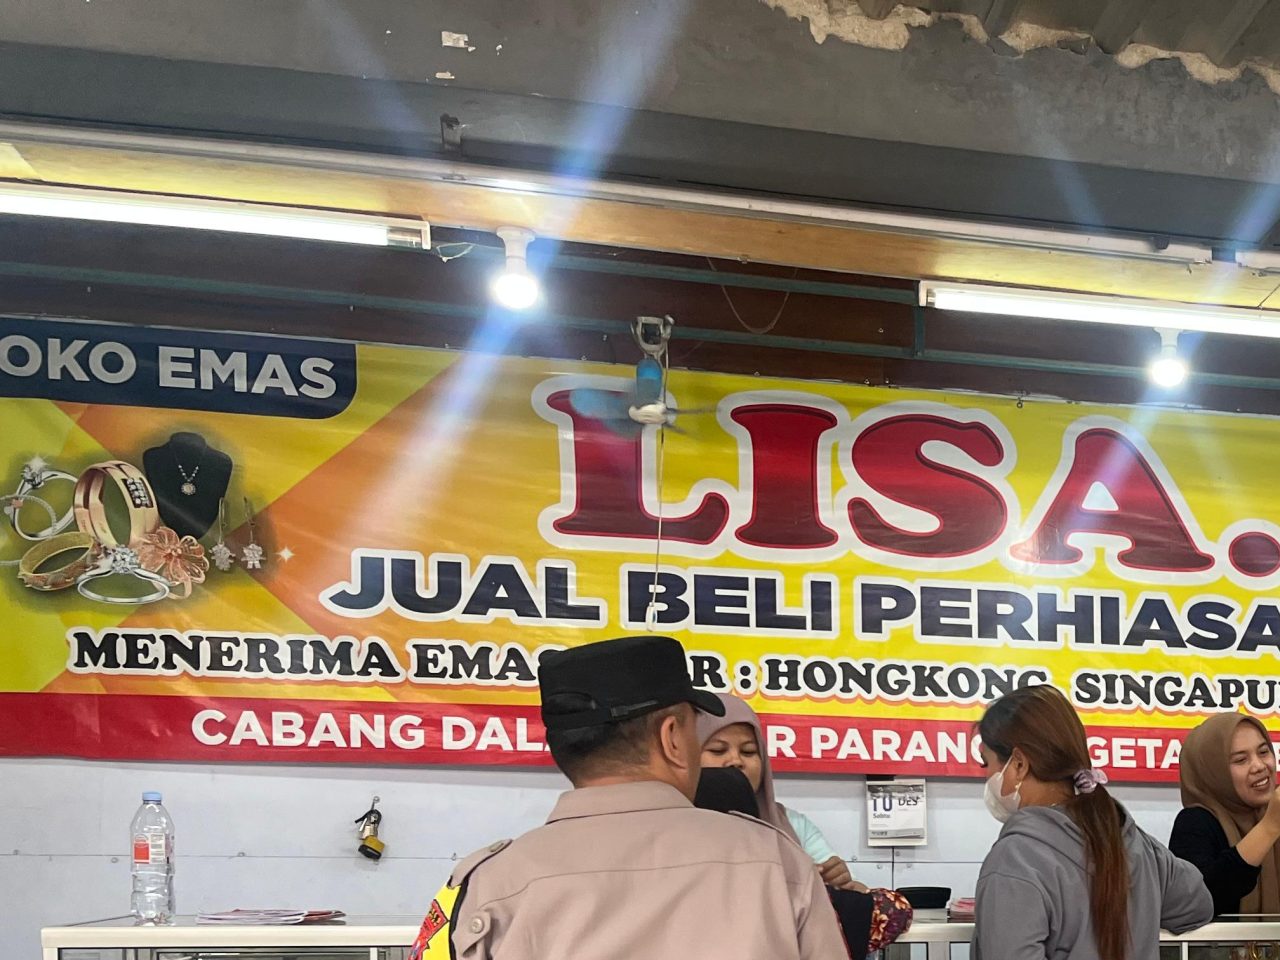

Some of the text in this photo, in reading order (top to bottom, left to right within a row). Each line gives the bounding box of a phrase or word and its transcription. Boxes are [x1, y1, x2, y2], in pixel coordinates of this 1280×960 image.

[0, 334, 337, 400] OKO EMAS
[327, 555, 601, 621] JUAL
[626, 570, 833, 632] BELI
[72, 632, 400, 680] MENERIMA
[412, 642, 541, 680] EMA
[190, 709, 425, 750] CABANG
[442, 715, 550, 752] DAL
